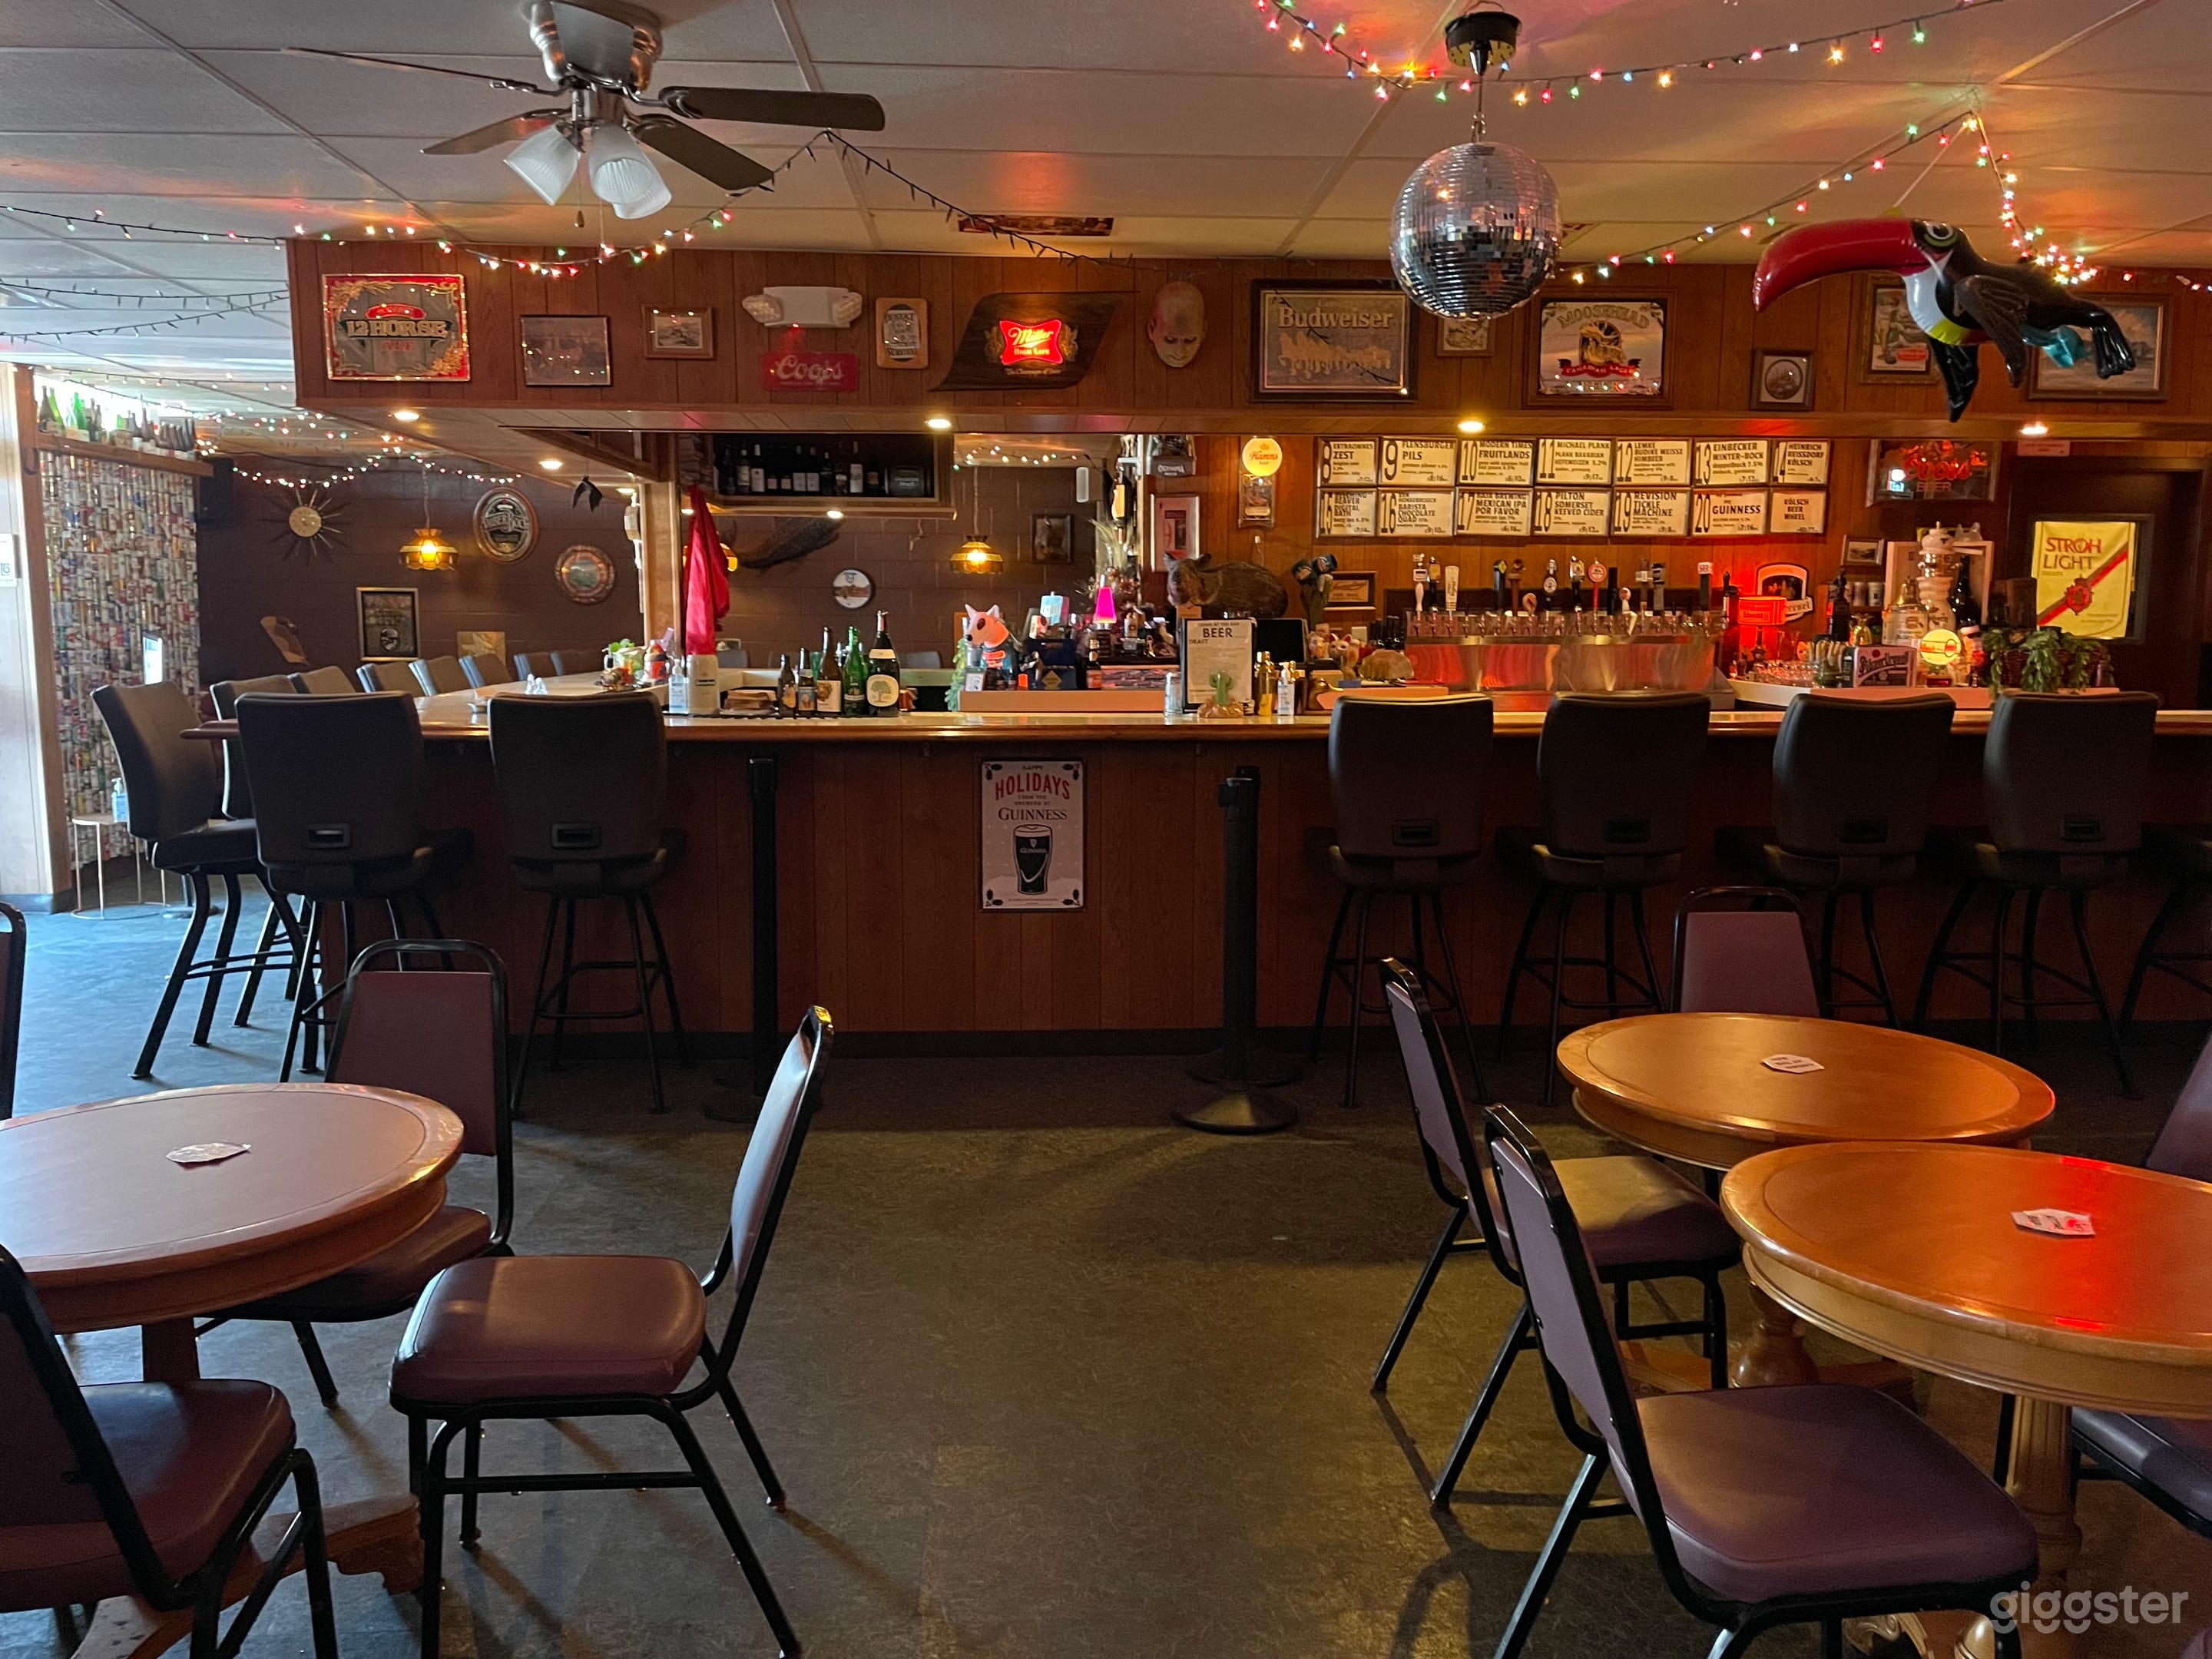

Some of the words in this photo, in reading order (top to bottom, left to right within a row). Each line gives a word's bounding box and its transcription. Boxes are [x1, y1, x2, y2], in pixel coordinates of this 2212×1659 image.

[1278, 307, 1394, 329] Budweiser
[1558, 305, 1649, 329] MOOSEHEAD
[346, 320, 368, 338] 12
[369, 320, 448, 338] HORSE
[1008, 327, 1055, 346] Miller
[1402, 452, 1422, 460] PILS
[1479, 450, 1530, 459] FRUITLANDS
[1540, 439, 1555, 478] 11
[1713, 443, 1758, 452] EINBECKER
[1322, 442, 1332, 483] 8
[1385, 440, 1398, 480] 9
[1462, 441, 1478, 482] 10
[1618, 442, 1634, 482] 12
[1695, 443, 1711, 485] 13
[1555, 492, 1585, 500] PILTON
[1634, 492, 1677, 500] REVISION
[1380, 492, 1397, 534] 16
[1458, 492, 1475, 531] 17
[1534, 492, 1551, 532] 18
[1614, 492, 1631, 533] 19
[1633, 508, 1673, 517] MACHINE
[1695, 493, 1710, 533] 20
[1713, 505, 1762, 514] GUINNESS
[2045, 538, 2101, 553] STROH
[2044, 554, 2097, 569] LIGHT
[1203, 628, 1233, 638] BEER
[995, 773, 1070, 800] HOLIDAYS
[998, 807, 1068, 820] GUINNESS
